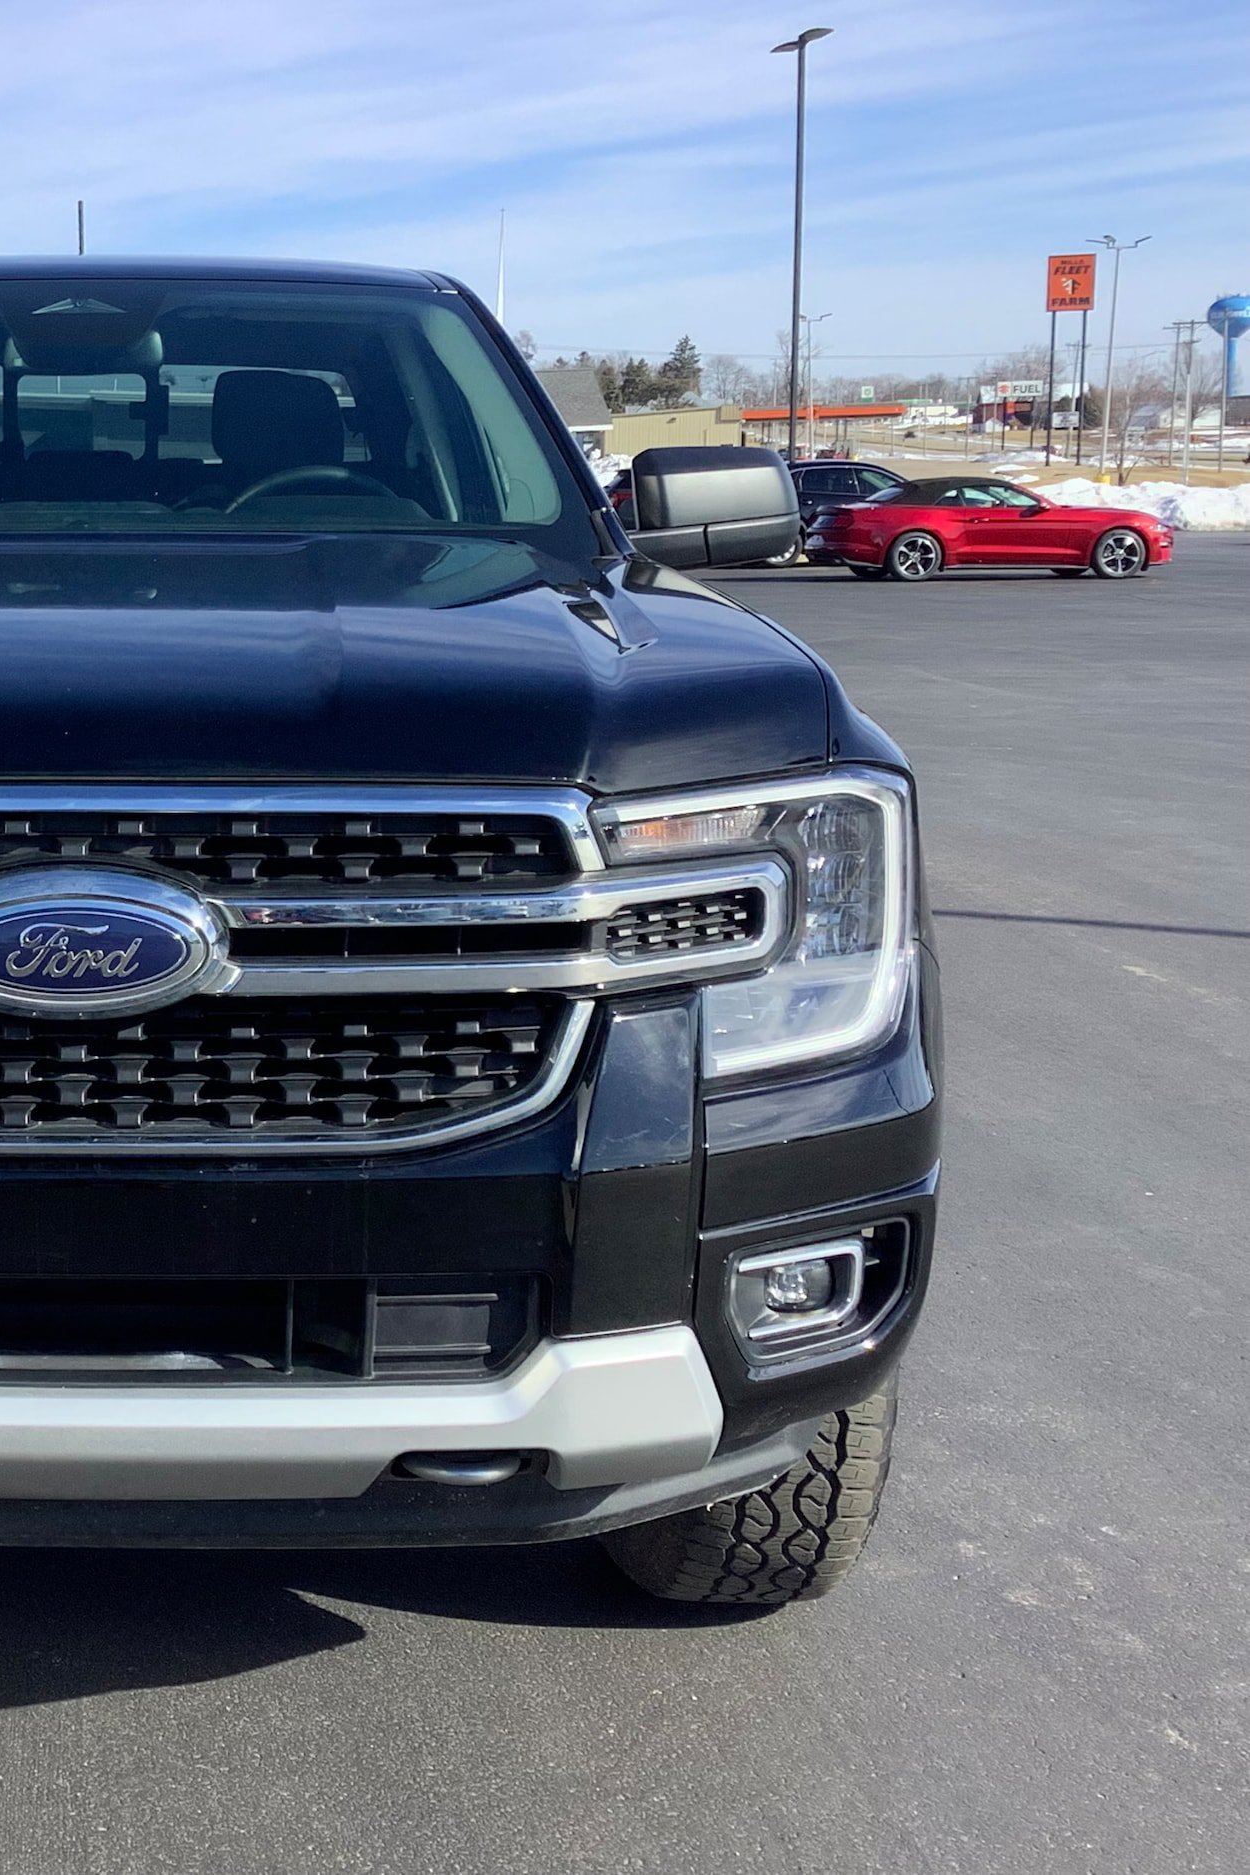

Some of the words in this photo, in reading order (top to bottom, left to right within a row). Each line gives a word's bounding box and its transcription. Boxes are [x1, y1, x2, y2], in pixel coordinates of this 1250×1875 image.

[1054, 265, 1091, 275] FLEET
[1051, 297, 1090, 306] FARM
[1013, 384, 1041, 394] FUEL
[5, 922, 143, 978] Ford
